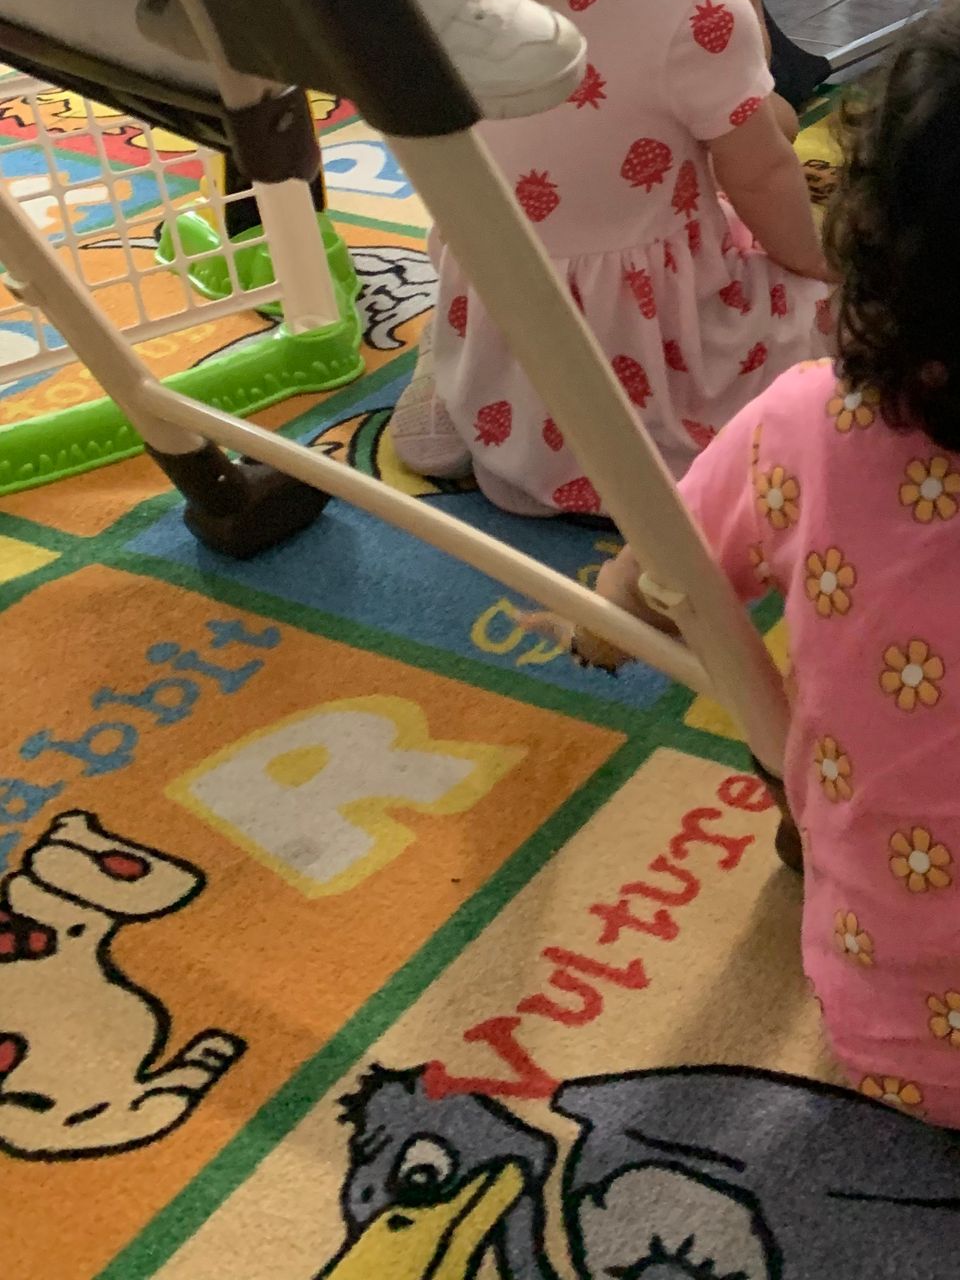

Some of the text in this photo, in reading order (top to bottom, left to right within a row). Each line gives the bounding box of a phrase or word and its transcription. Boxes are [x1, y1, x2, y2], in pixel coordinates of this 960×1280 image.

[0, 619, 282, 871] abbit
[163, 693, 529, 900] R
[423, 773, 776, 1101] Vulture
